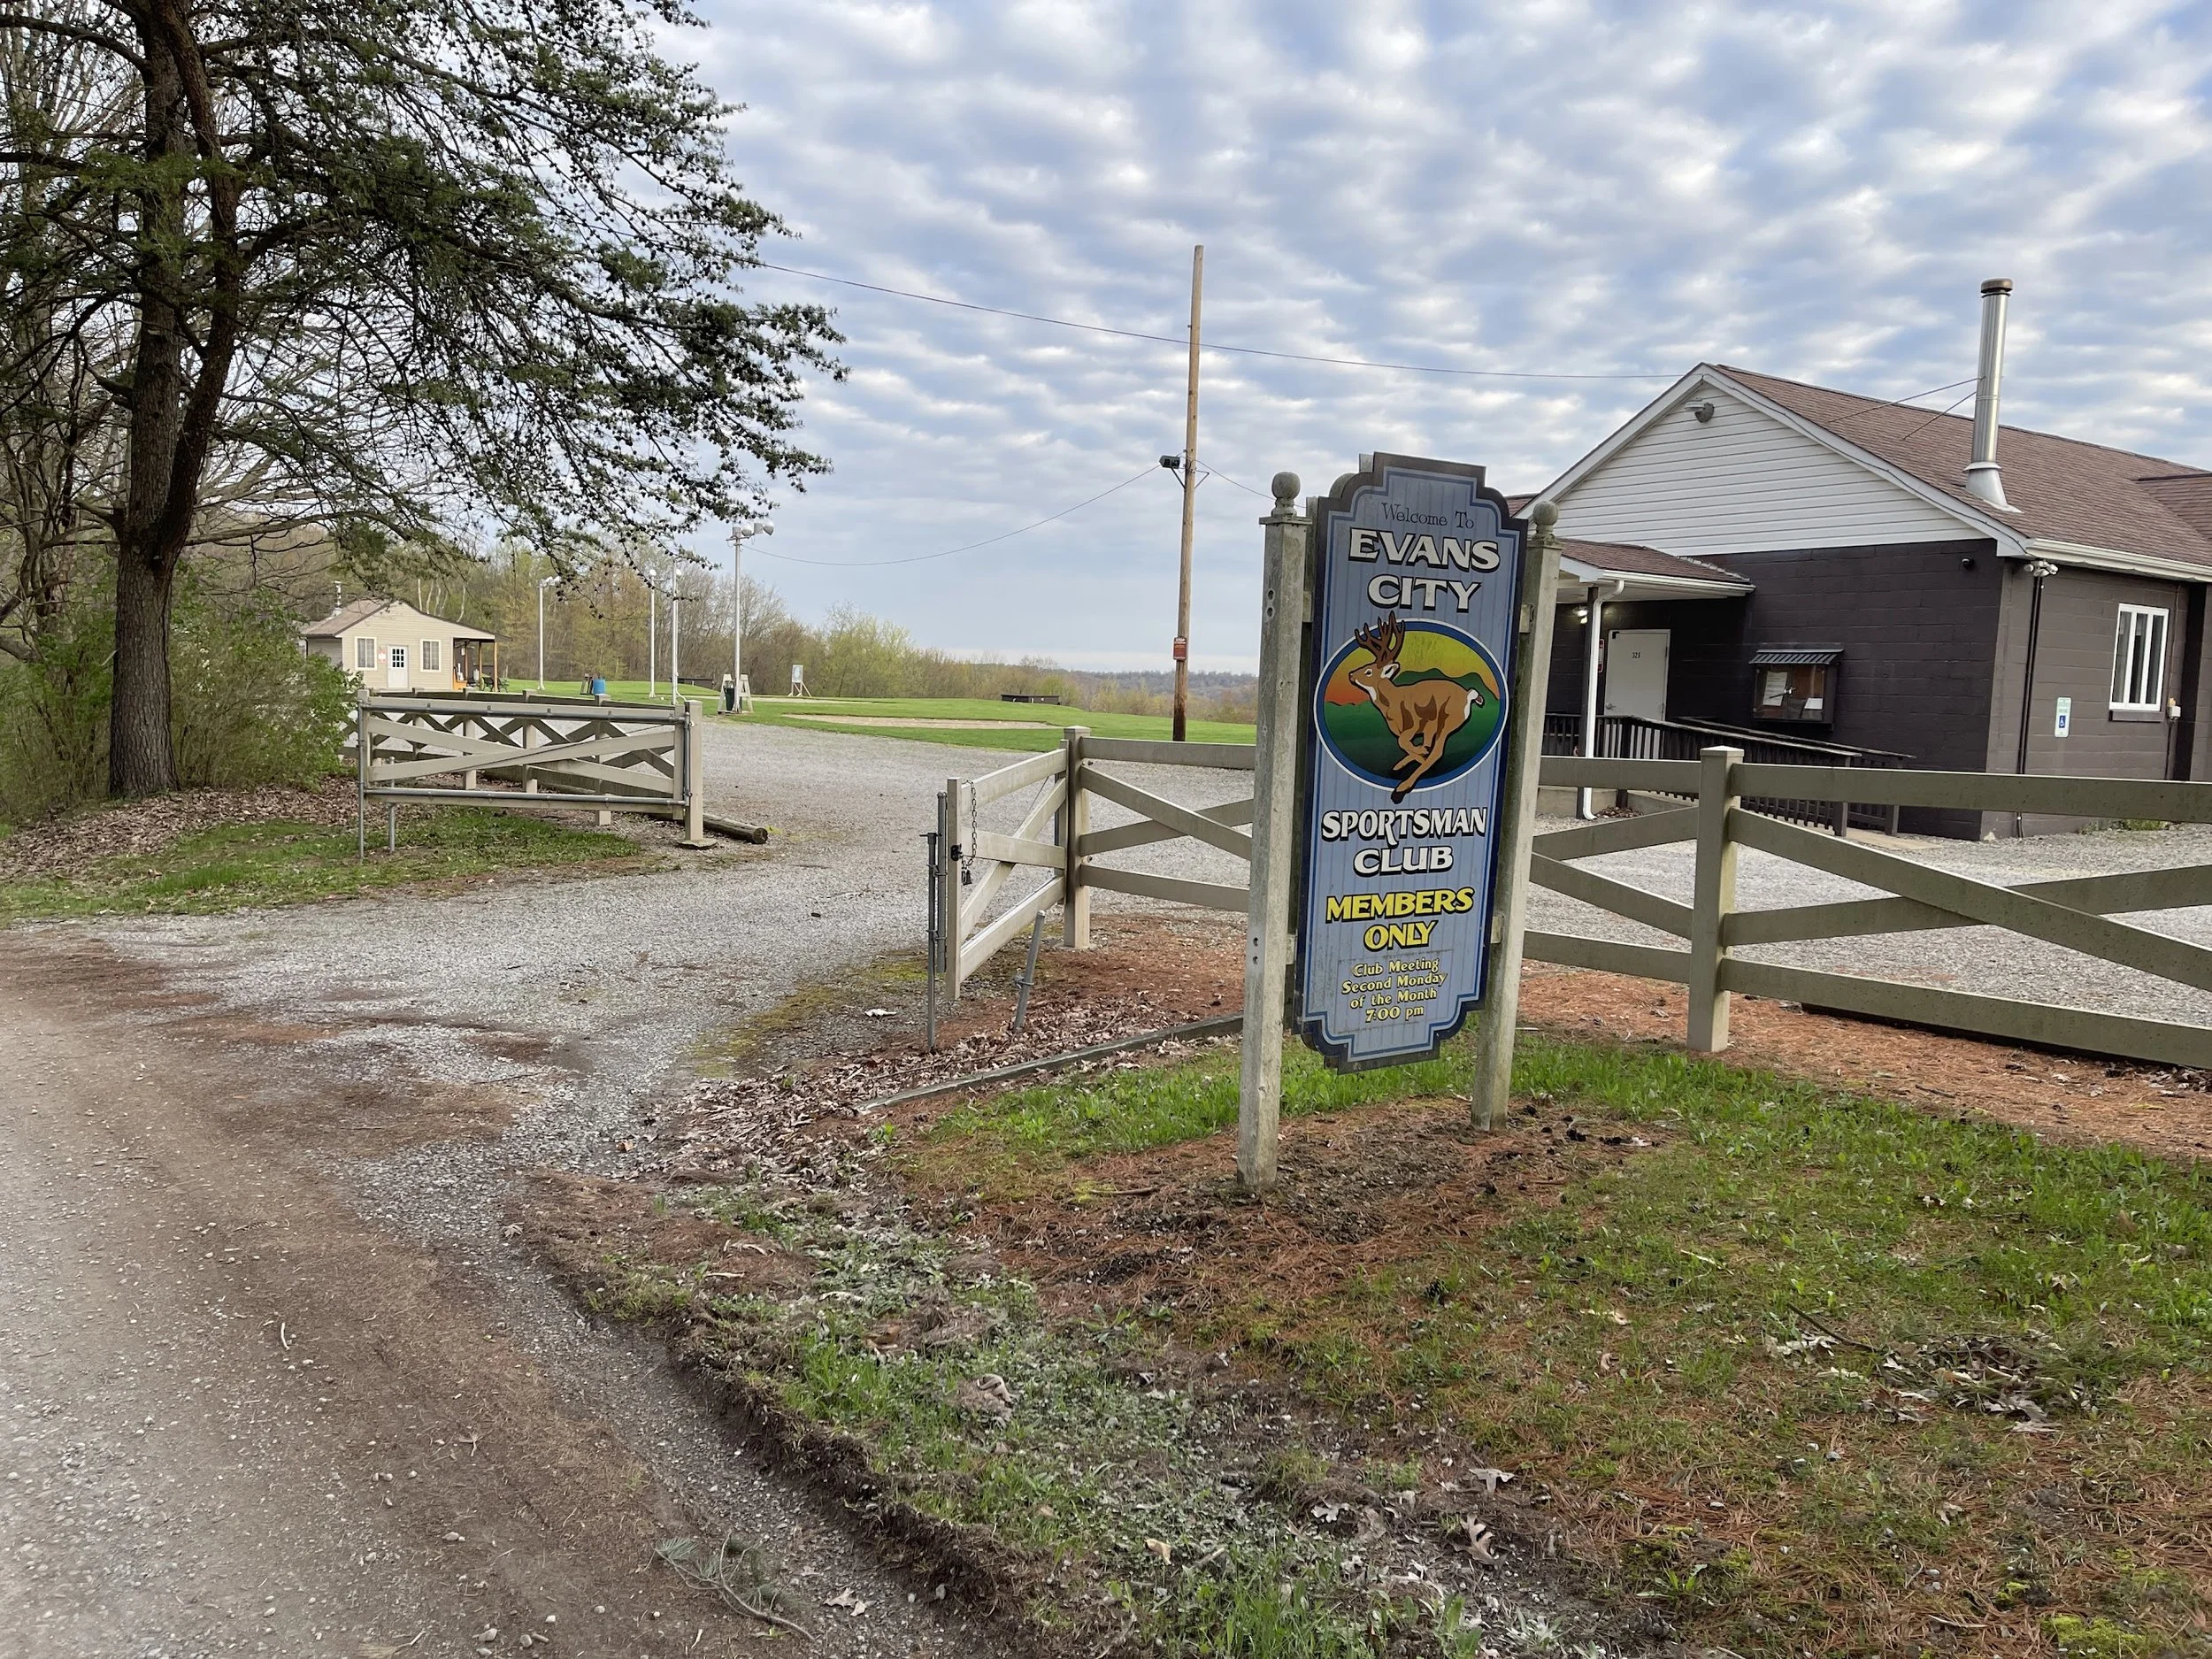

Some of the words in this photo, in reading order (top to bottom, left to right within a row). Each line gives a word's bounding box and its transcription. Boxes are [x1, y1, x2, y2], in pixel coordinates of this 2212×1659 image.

[1381, 502, 1448, 526] Welcome
[1455, 510, 1475, 529] To
[1348, 527, 1501, 573] EVANS
[1367, 574, 1481, 613] CITY
[1321, 807, 1487, 848] SPORTSMAN
[1354, 846, 1454, 878] CLUB
[1325, 887, 1475, 924] MEMBERS
[1363, 919, 1439, 951] ONLY
[1341, 977, 1391, 995] Second
[1397, 972, 1448, 988] Monday
[1352, 962, 1383, 978] Club
[1388, 957, 1440, 973] Meeting
[1350, 995, 1365, 1010] of
[1371, 992, 1392, 1007] the
[1397, 987, 1437, 1003] Month
[1365, 1006, 1401, 1023] 7:00
[1405, 1005, 1424, 1020] pm
